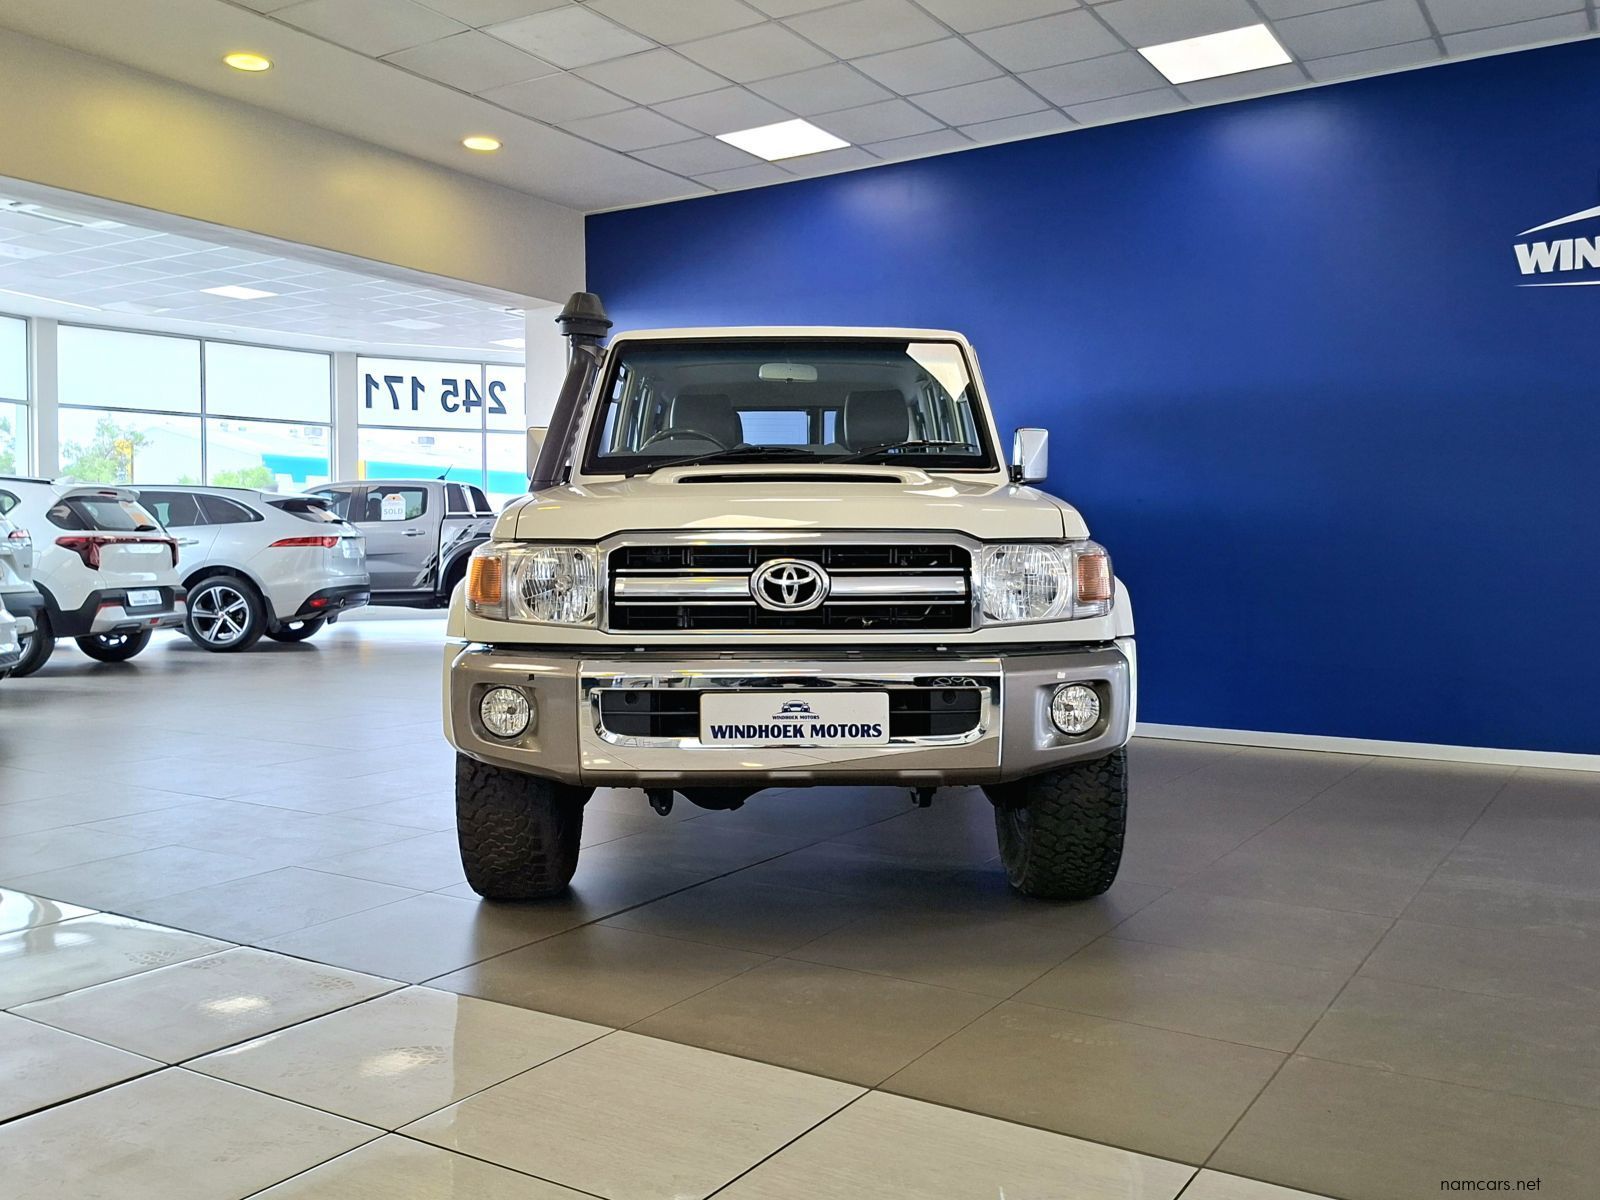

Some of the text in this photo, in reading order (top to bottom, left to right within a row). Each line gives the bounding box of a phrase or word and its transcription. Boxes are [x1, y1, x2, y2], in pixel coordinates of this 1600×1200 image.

[383, 507, 404, 516] SOLD
[710, 723, 883, 739] WINDHOEK MOTORS
